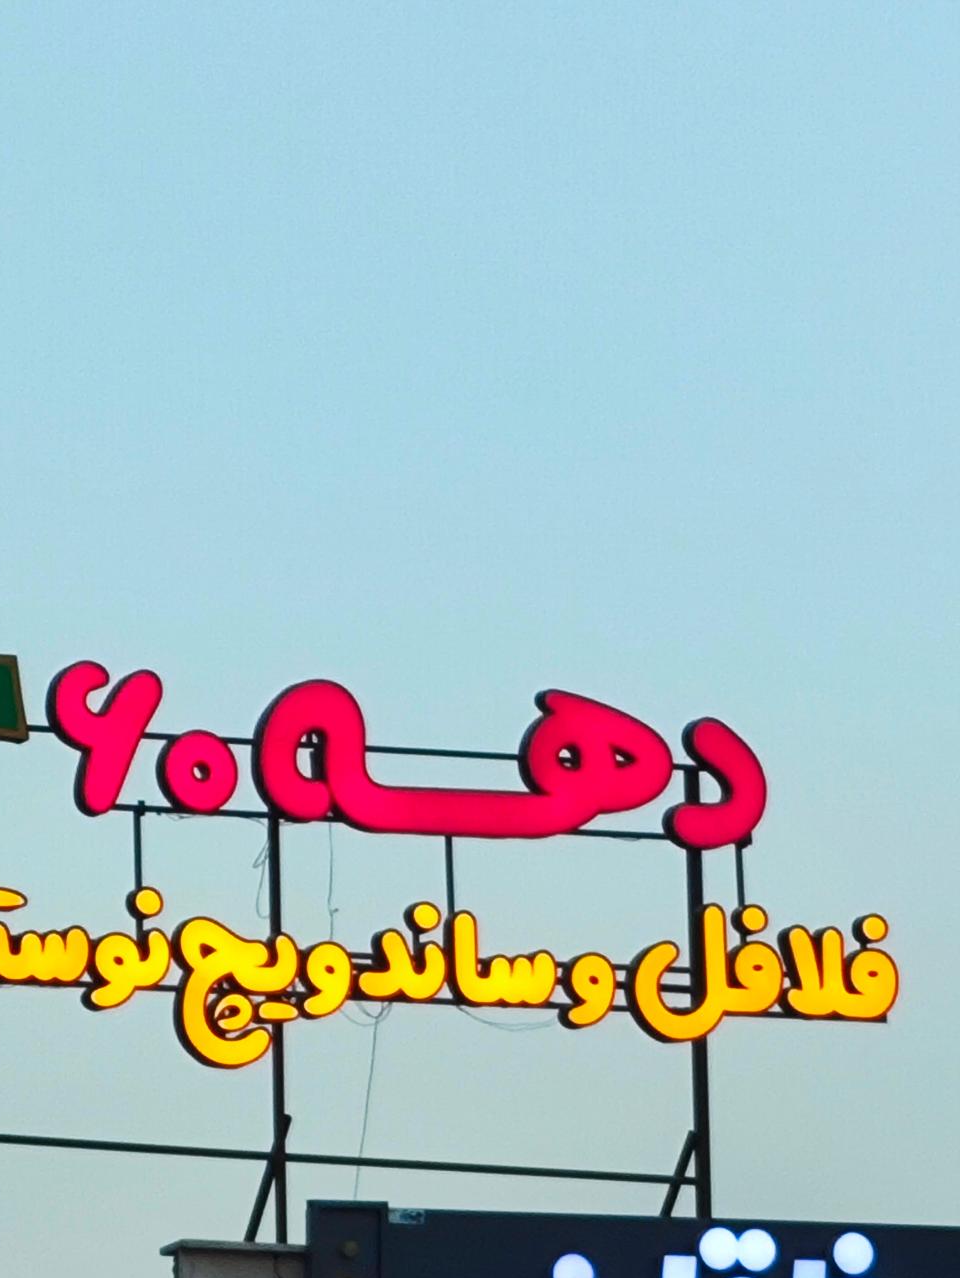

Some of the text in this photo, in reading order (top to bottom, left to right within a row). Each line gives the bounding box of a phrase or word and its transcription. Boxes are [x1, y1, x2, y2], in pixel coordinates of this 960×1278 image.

[252, 681, 767, 849] دهه
[176, 902, 559, 1069] ساندویچ
[559, 952, 618, 1029] و
[628, 904, 900, 1042] فلافل
